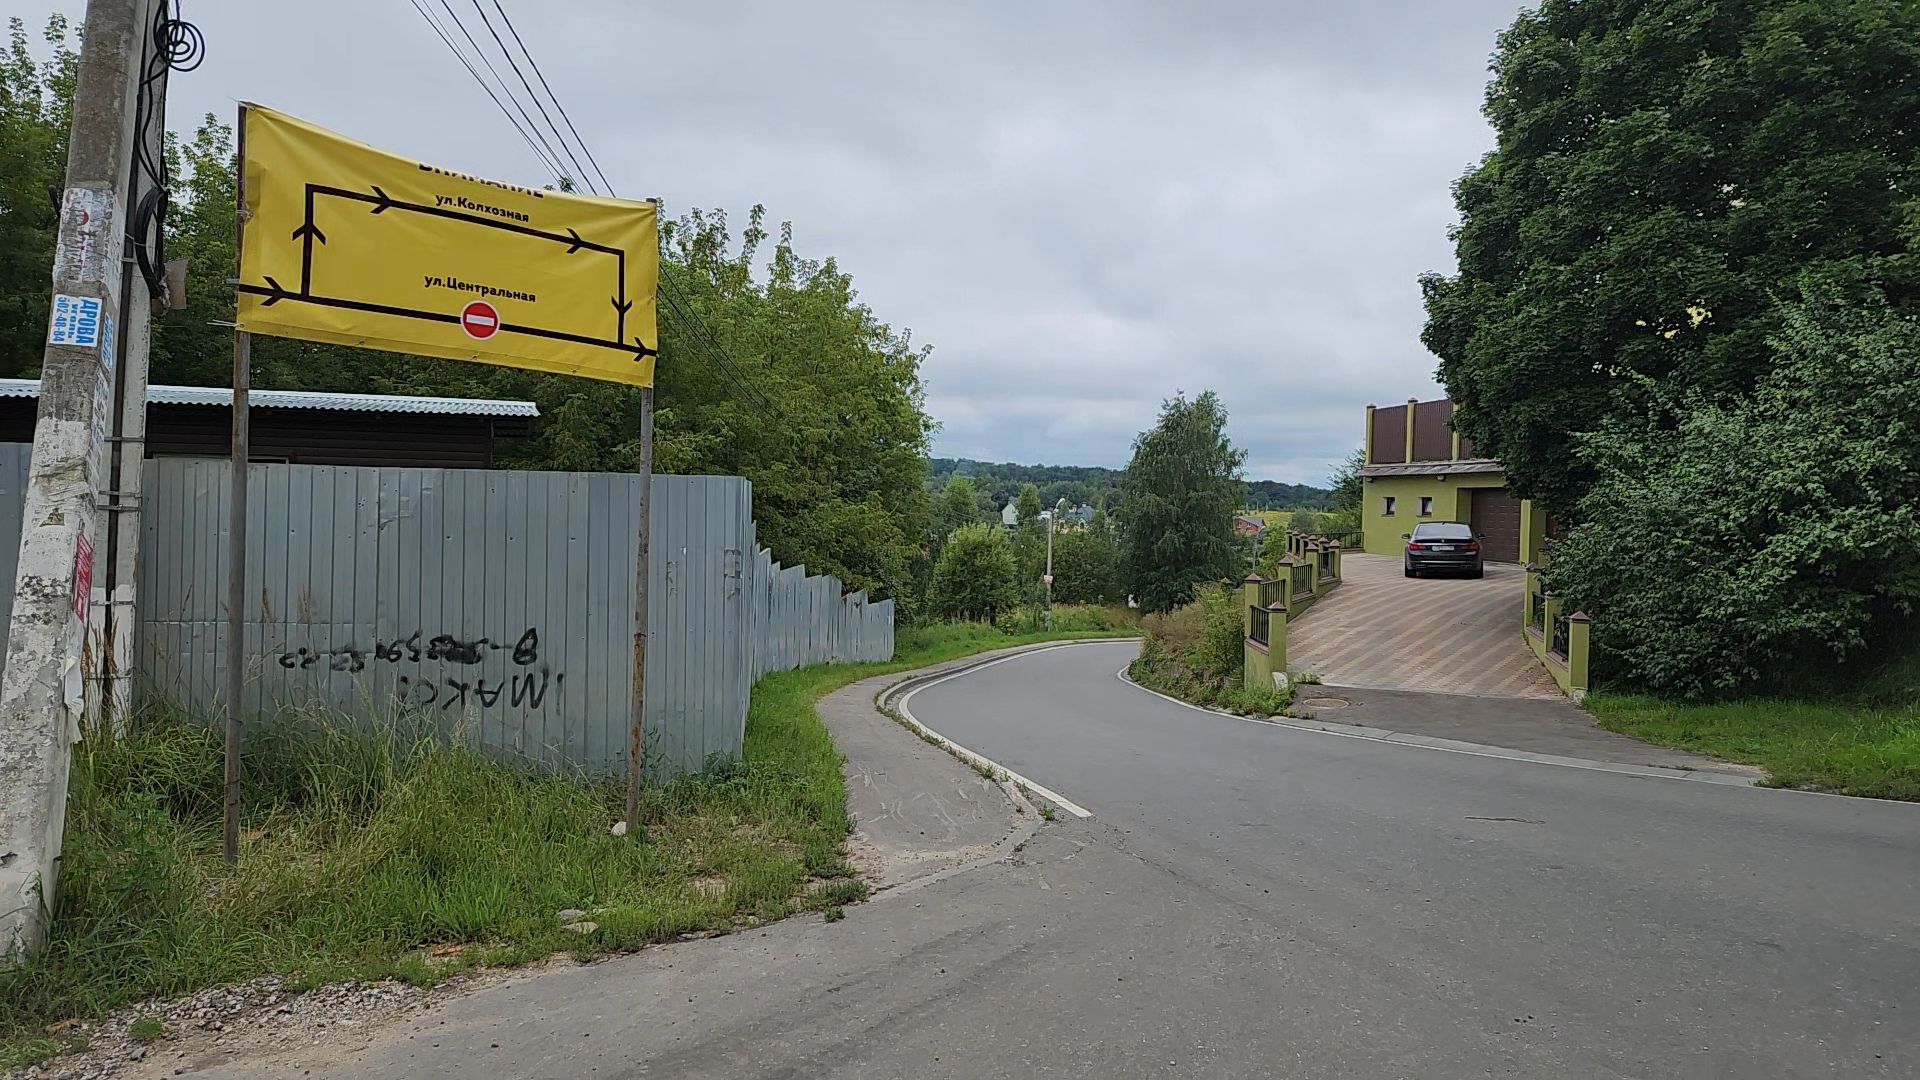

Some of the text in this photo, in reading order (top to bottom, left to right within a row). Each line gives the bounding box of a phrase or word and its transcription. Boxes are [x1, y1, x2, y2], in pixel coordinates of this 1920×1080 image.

[435, 195, 528, 222] ул.Колхозная
[424, 275, 536, 302] ул.Центральная
[76, 299, 98, 343] ДРОВА
